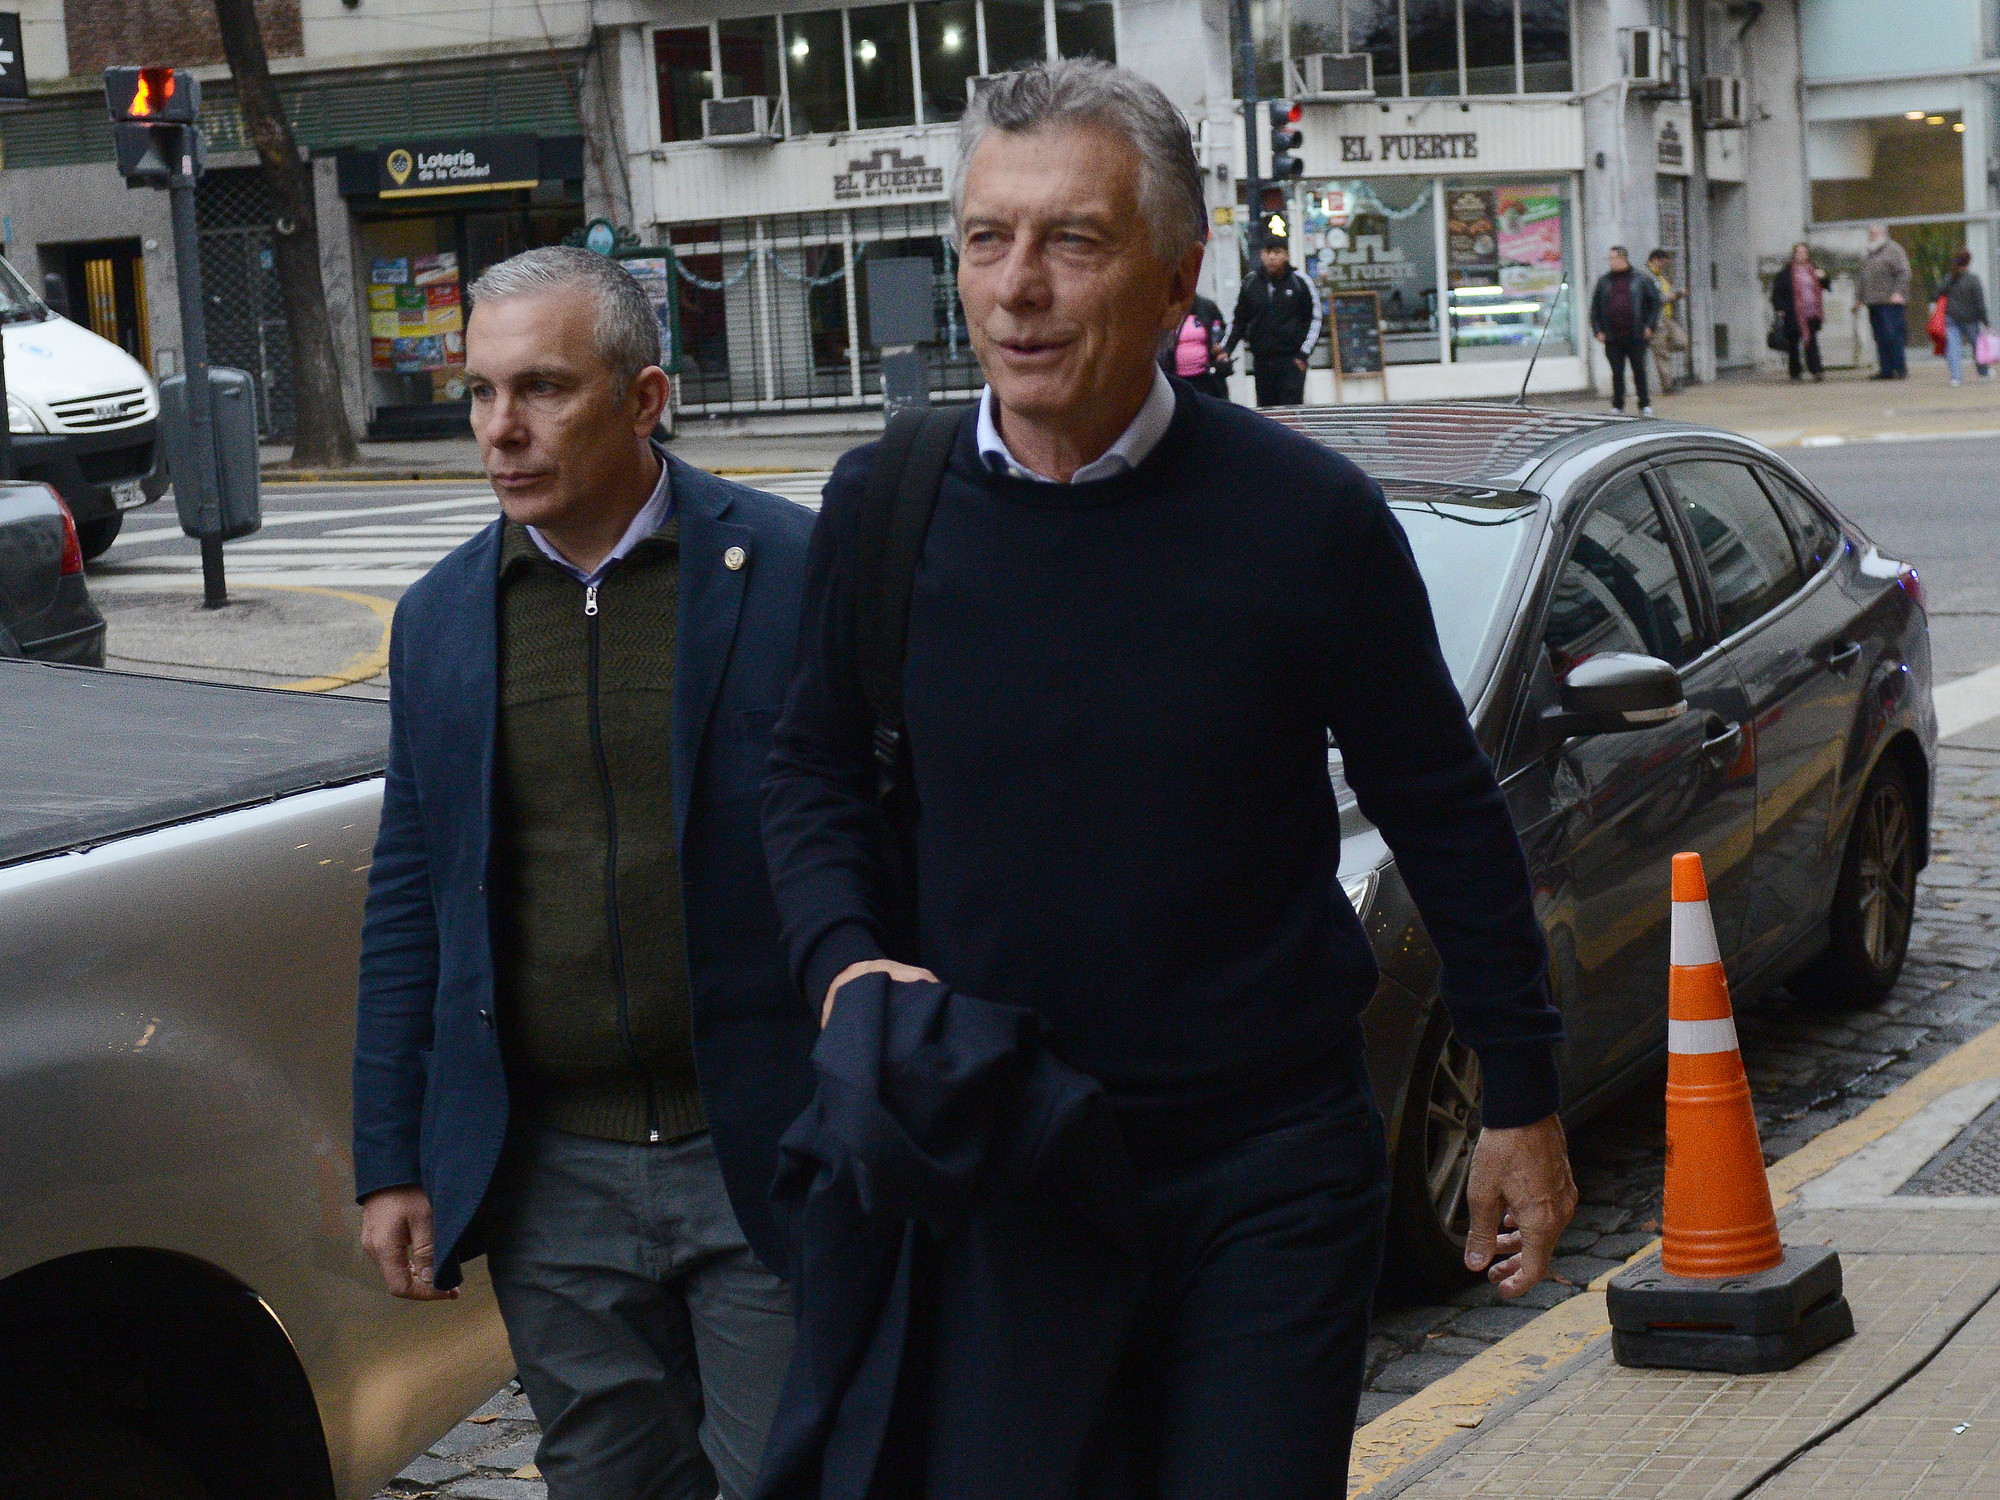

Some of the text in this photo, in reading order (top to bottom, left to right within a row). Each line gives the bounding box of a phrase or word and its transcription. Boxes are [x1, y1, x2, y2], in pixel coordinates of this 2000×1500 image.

[1341, 132, 1477, 161] EL FUERTE
[417, 149, 475, 170] Lotería
[418, 163, 490, 181] de la Ciudad
[834, 167, 942, 191] EL FUERTE
